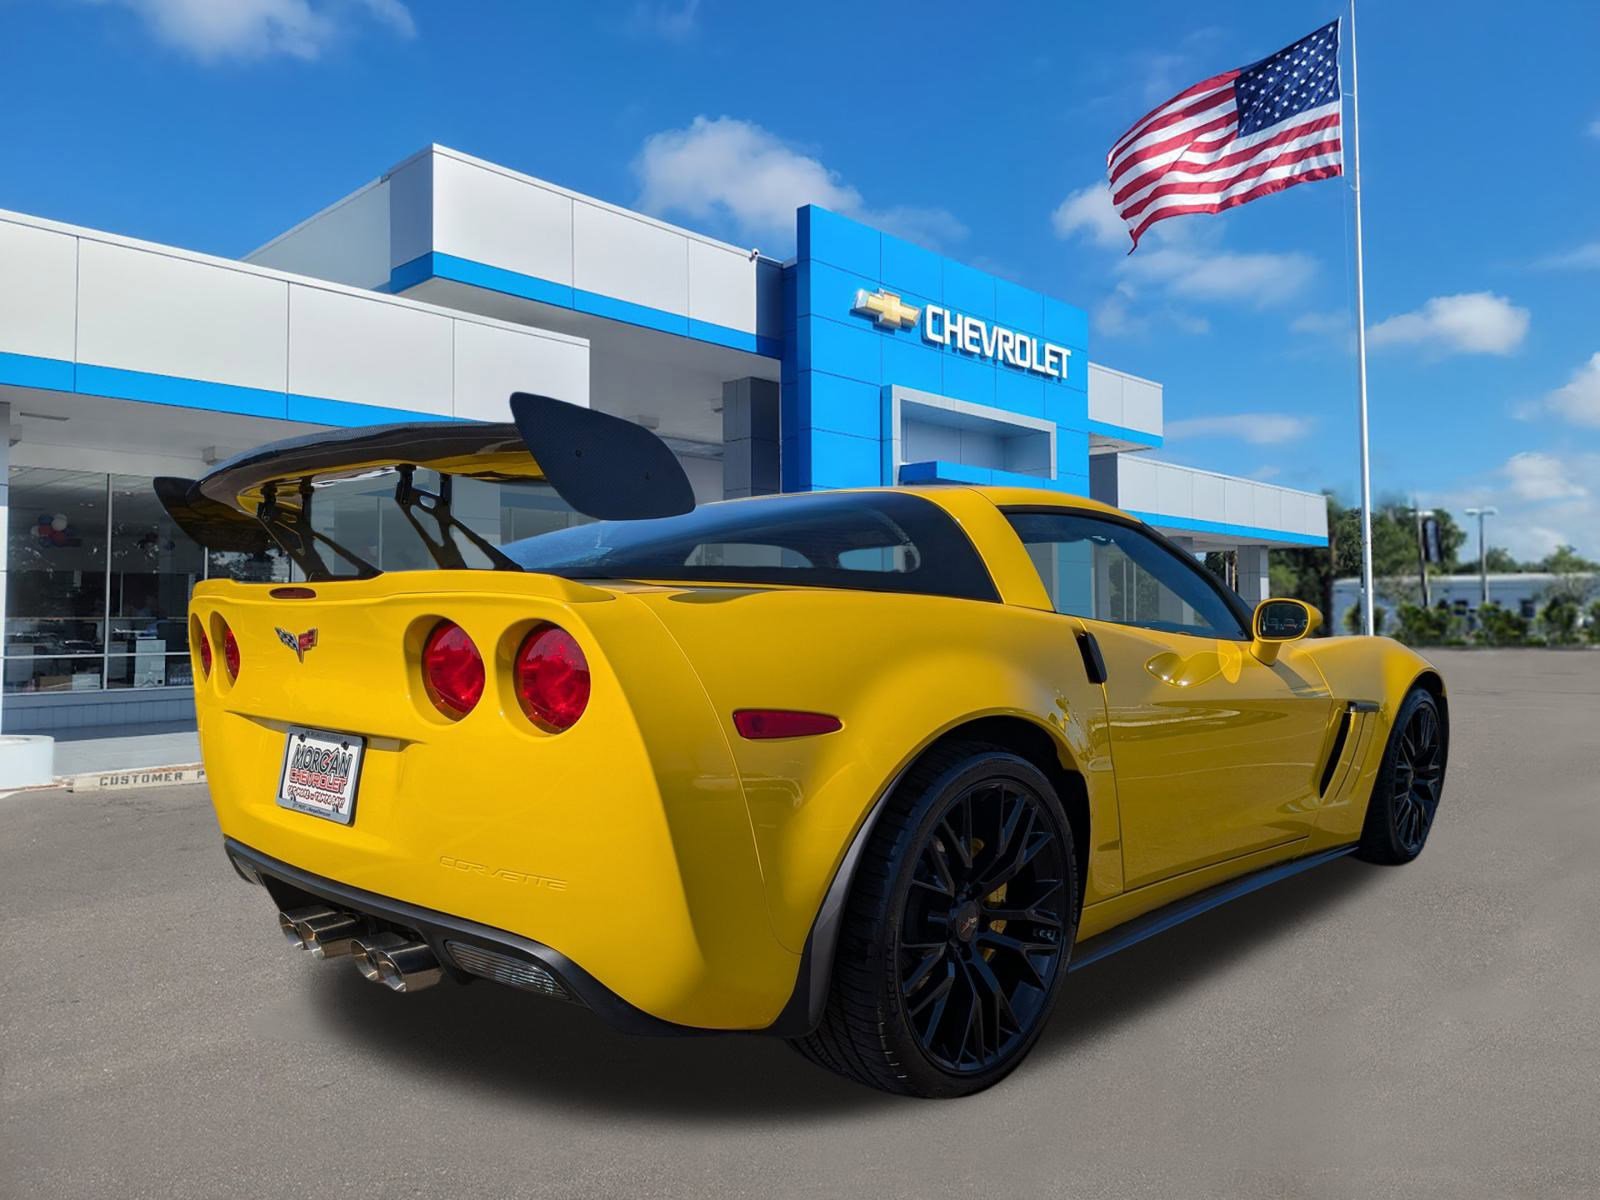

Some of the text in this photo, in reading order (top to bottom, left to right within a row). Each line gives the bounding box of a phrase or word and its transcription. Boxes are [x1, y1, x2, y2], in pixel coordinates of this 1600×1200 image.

[925, 304, 1072, 379] CHEVROLET
[291, 744, 353, 777] MORGAN
[100, 772, 183, 786] CUSTOMER
[290, 767, 347, 794] CHEVROLET
[439, 855, 569, 892] CORVETTE
